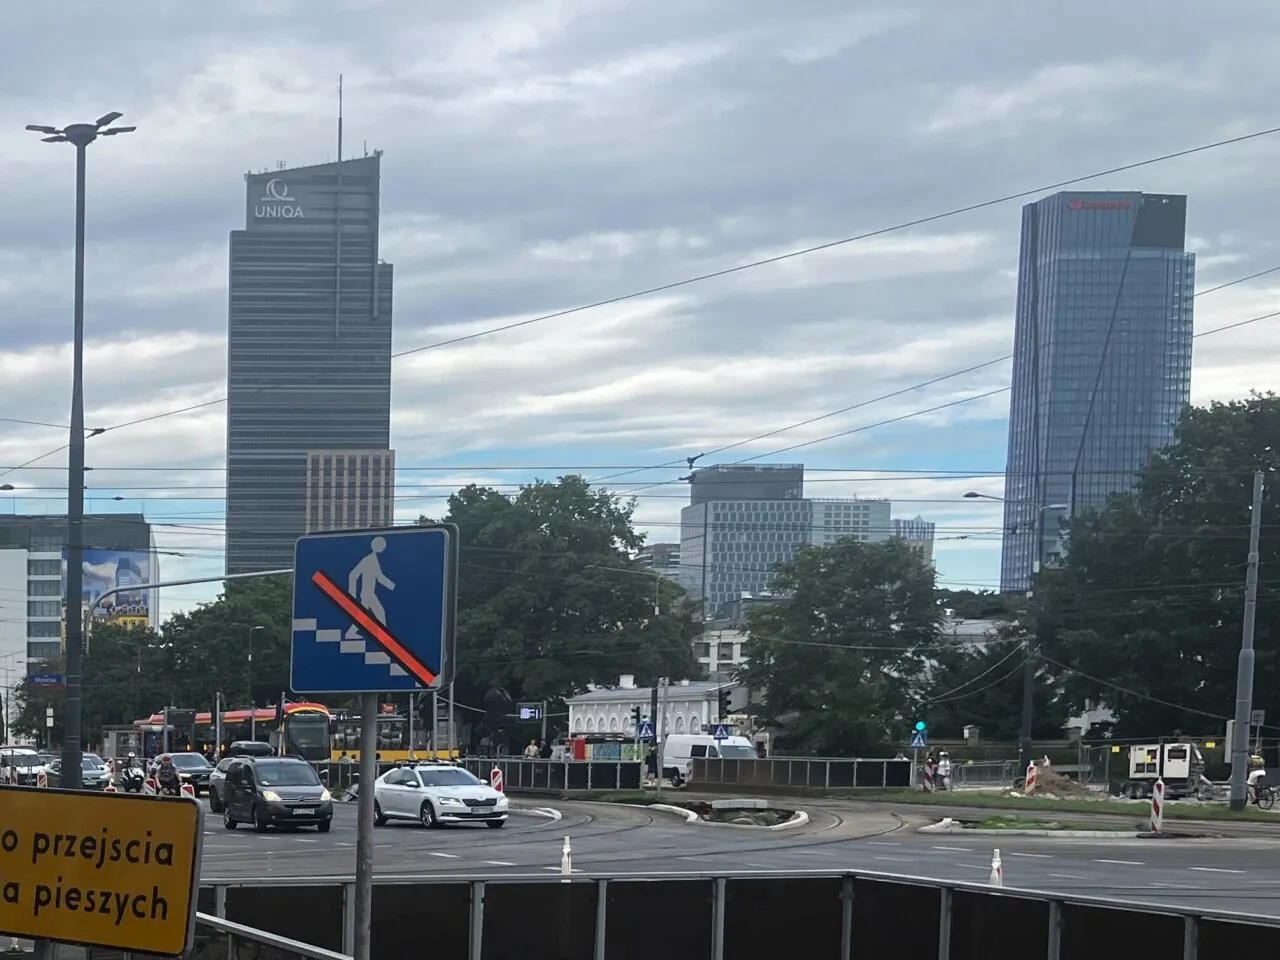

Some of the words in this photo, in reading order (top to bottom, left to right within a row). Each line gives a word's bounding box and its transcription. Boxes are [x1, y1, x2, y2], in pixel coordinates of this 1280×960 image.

[254, 205, 304, 218] UNIQA
[32, 827, 174, 870] przejscia
[34, 876, 168, 926] pieszych
